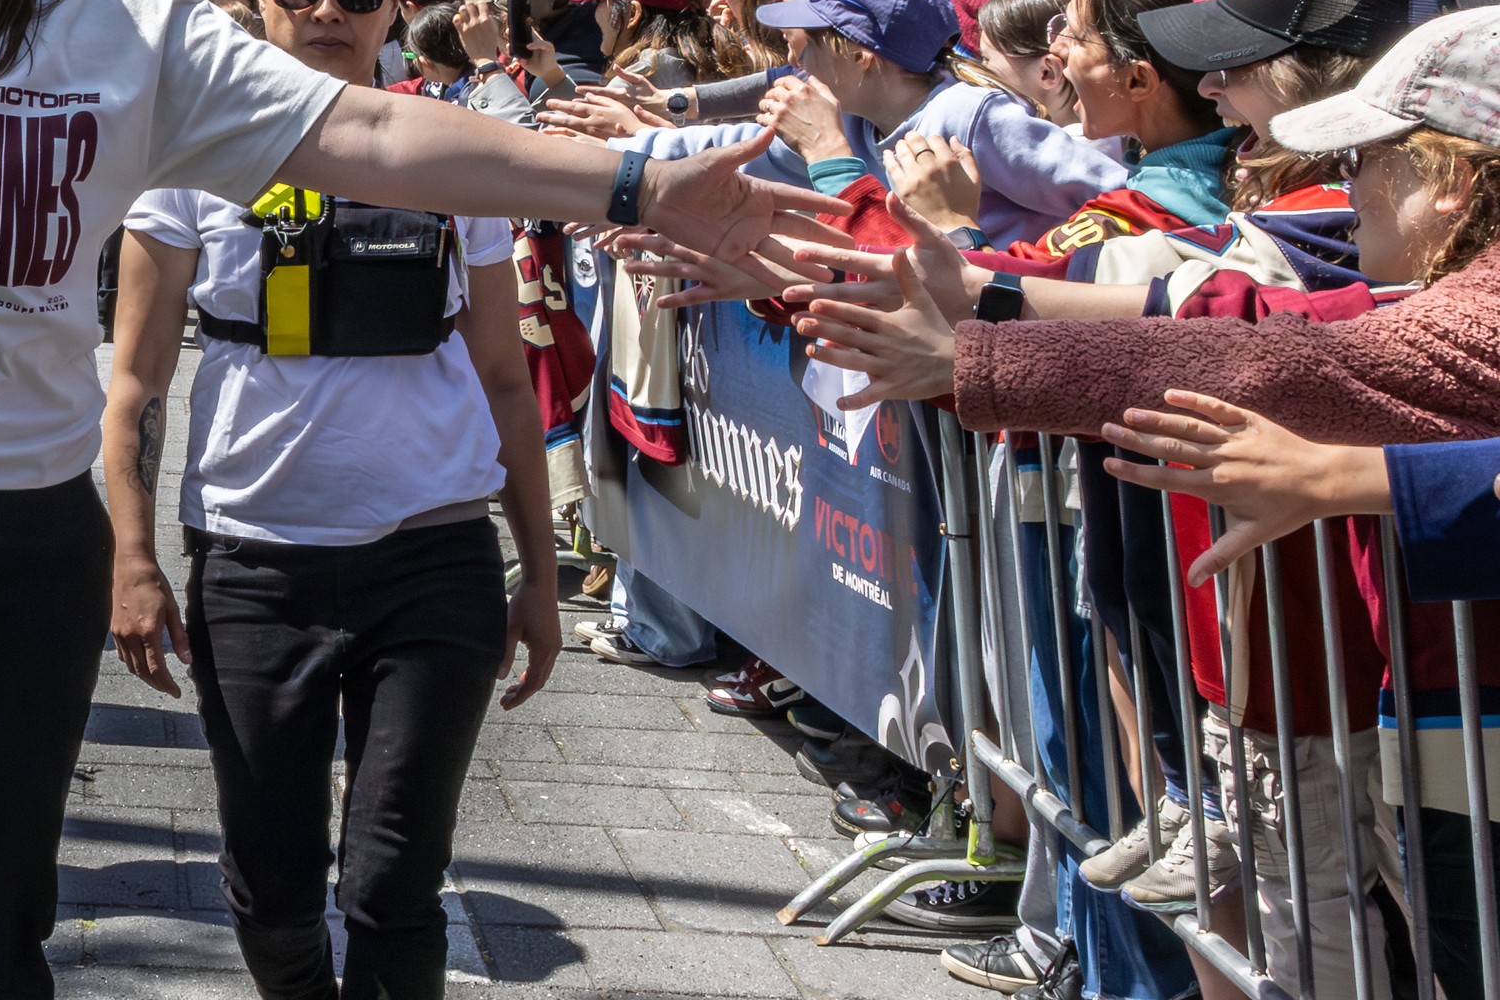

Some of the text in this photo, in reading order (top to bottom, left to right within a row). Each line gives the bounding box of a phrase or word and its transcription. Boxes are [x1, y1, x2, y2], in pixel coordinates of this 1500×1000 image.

[368, 242, 416, 251] MOTOROLA
[869, 465, 912, 494] AIR CANADA
[832, 562, 893, 611] DE MONTRÉAL
